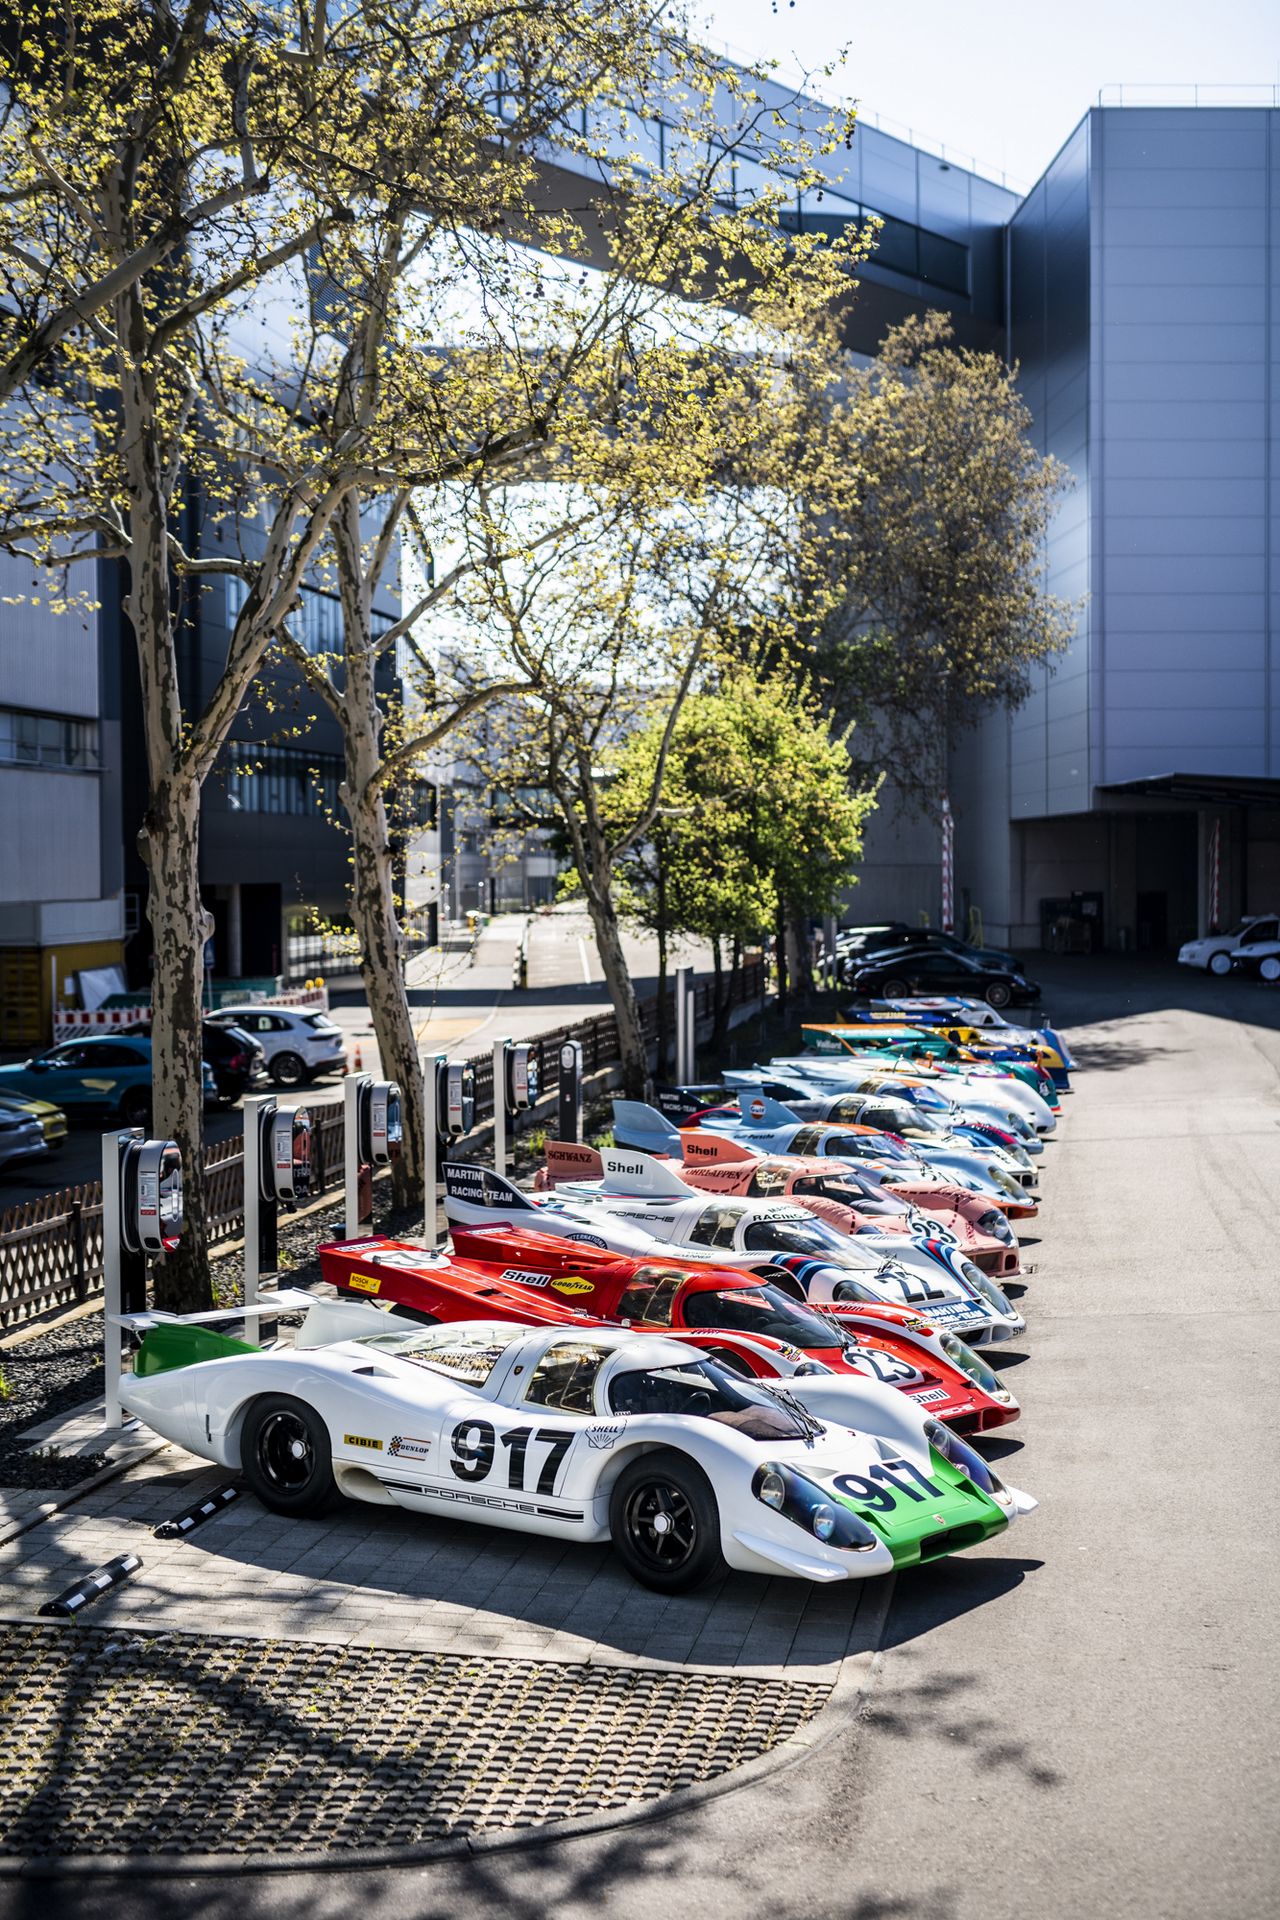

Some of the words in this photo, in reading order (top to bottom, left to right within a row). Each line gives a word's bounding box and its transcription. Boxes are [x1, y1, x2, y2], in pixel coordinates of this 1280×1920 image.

[548, 1150, 592, 1163] SCHWANZ
[686, 1145, 718, 1157] Shell
[447, 1168, 484, 1181] MARTINI
[607, 1161, 643, 1174] Shell
[607, 1210, 676, 1222] PORSCHE
[912, 1221, 957, 1243] 23
[568, 1234, 607, 1249] NTERNATIONA
[352, 1276, 369, 1285] BOSCH
[503, 1270, 549, 1286] Shell
[844, 1349, 917, 1383] 23
[909, 1390, 948, 1404] Shell
[400, 1444, 430, 1454] DUNLOP
[450, 1419, 576, 1496] 917
[832, 1460, 945, 1512] 917
[424, 1487, 536, 1513] PORSCHE
